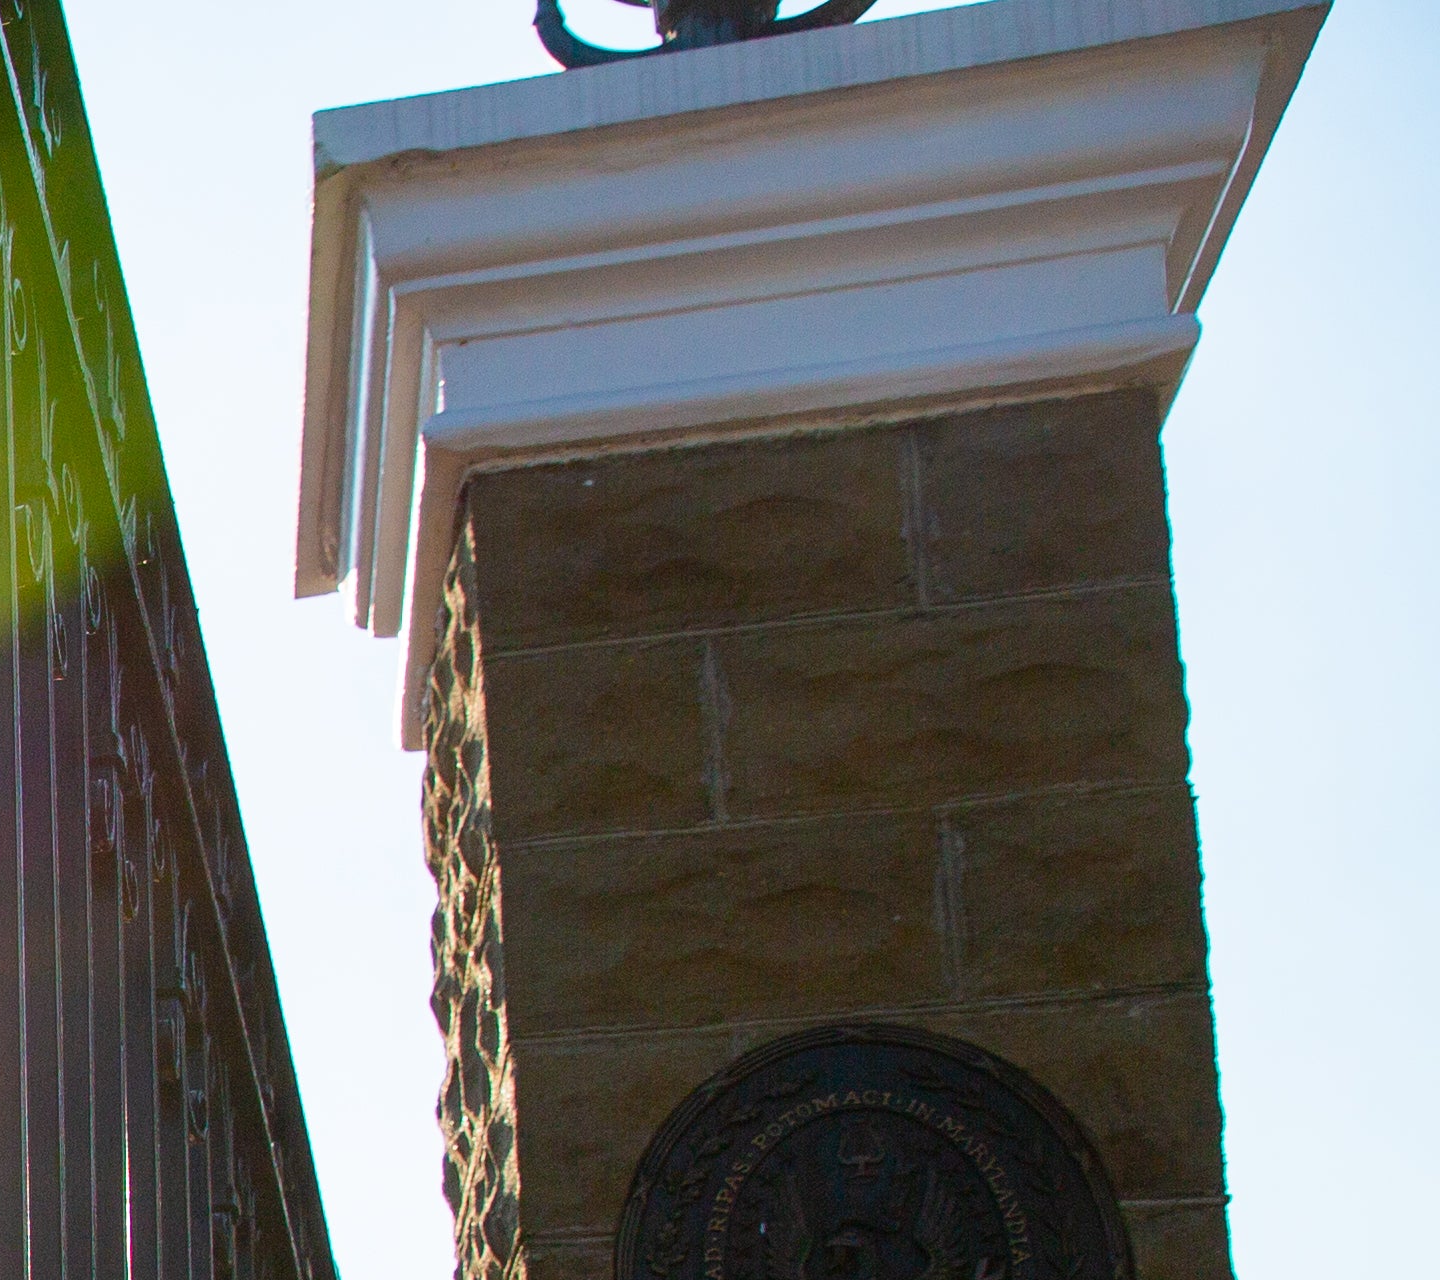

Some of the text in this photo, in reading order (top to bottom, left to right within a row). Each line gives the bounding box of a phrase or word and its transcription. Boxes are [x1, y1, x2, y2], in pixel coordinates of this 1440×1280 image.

[708, 1161, 752, 1232] RIPAS
[751, 1090, 892, 1150] POTOMACI
[906, 1099, 936, 1121] IN
[936, 1116, 1032, 1266] MARYLANDIA
